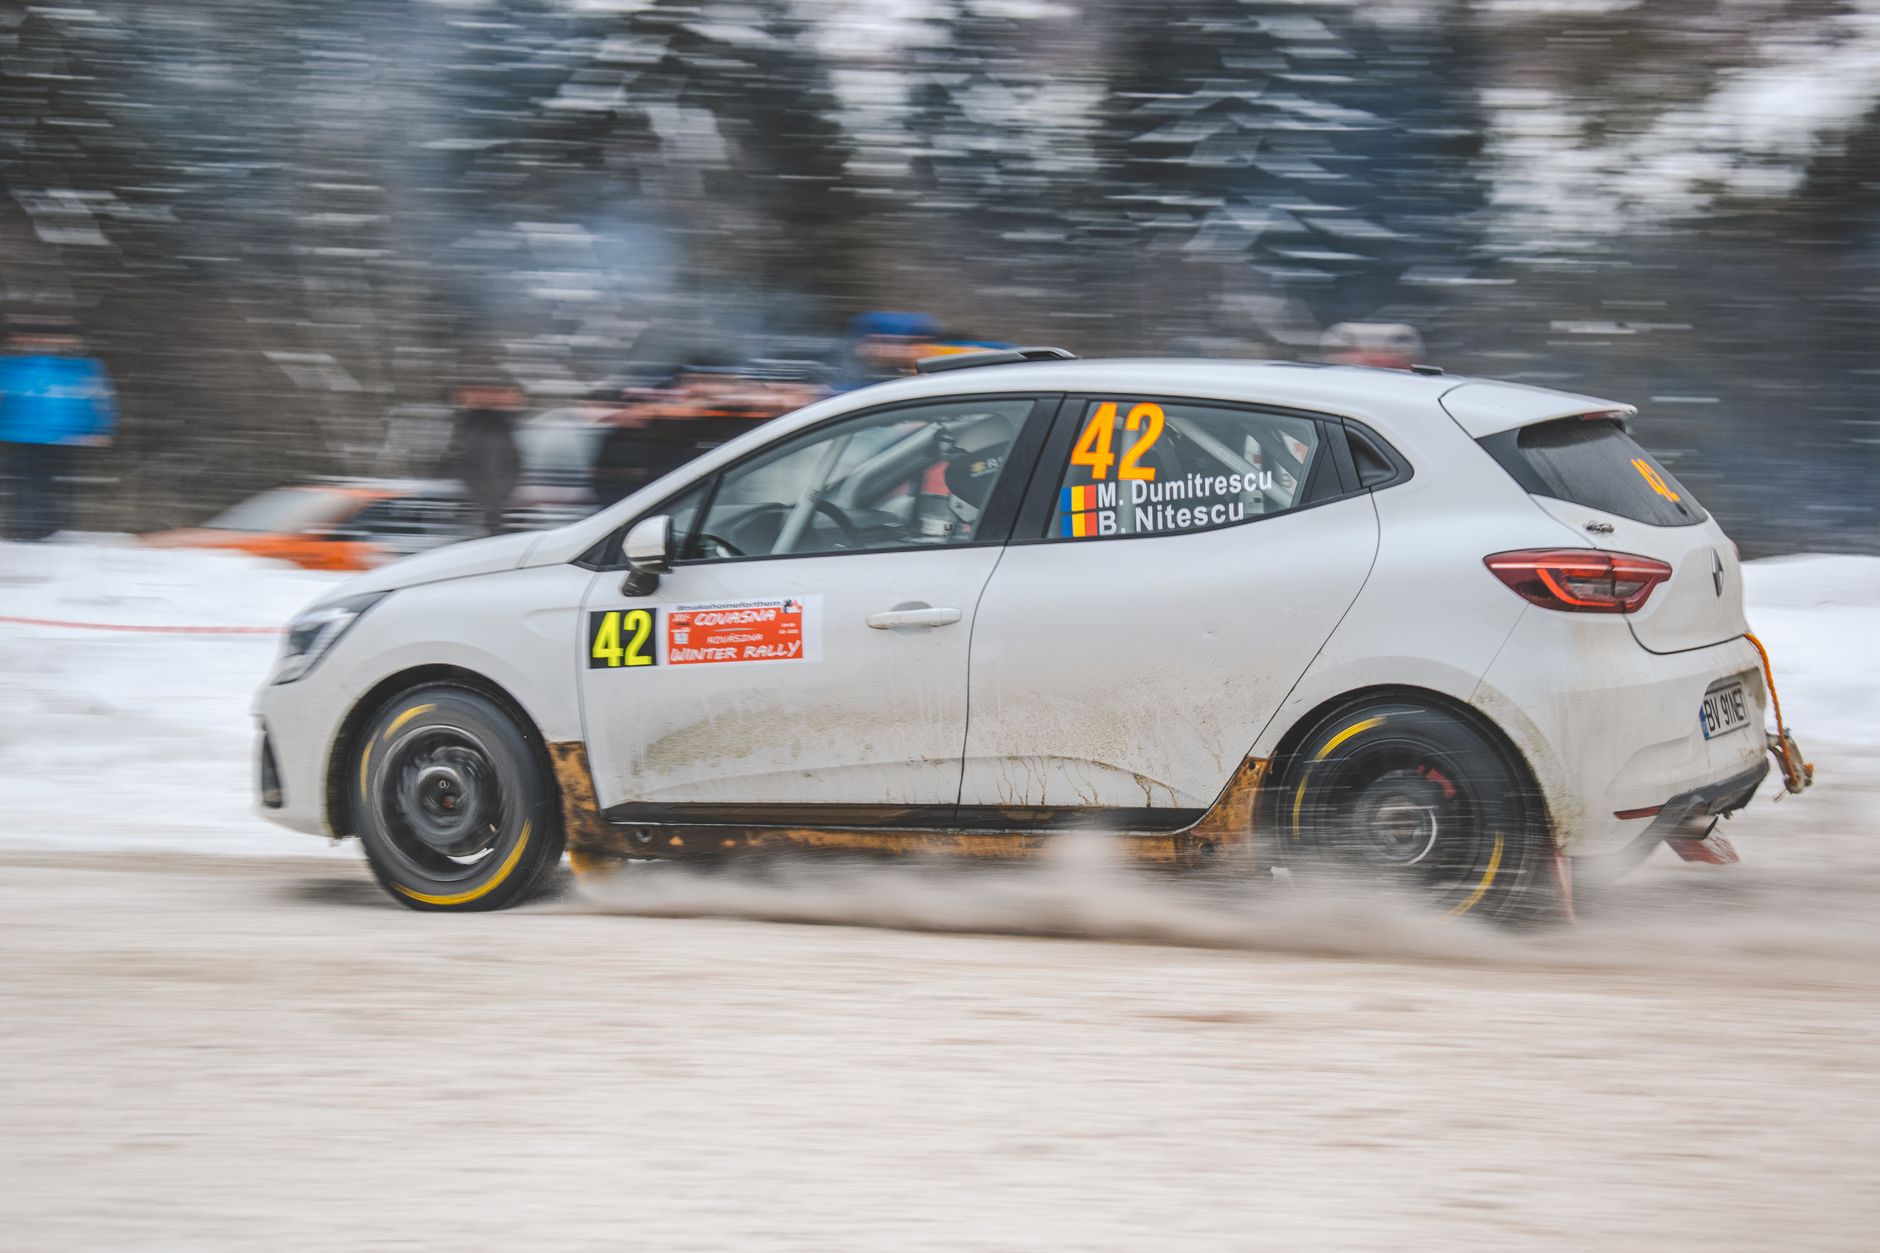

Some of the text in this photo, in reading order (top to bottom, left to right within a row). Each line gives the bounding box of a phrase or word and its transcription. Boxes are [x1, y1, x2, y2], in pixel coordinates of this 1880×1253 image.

[1070, 401, 1165, 481] 42
[1097, 470, 1273, 508] M. Dumitrescu
[1098, 502, 1244, 536] B. Nitescu
[694, 608, 777, 627] COVASNA
[592, 609, 653, 667] 42
[671, 639, 801, 662] WINTER RALLY
